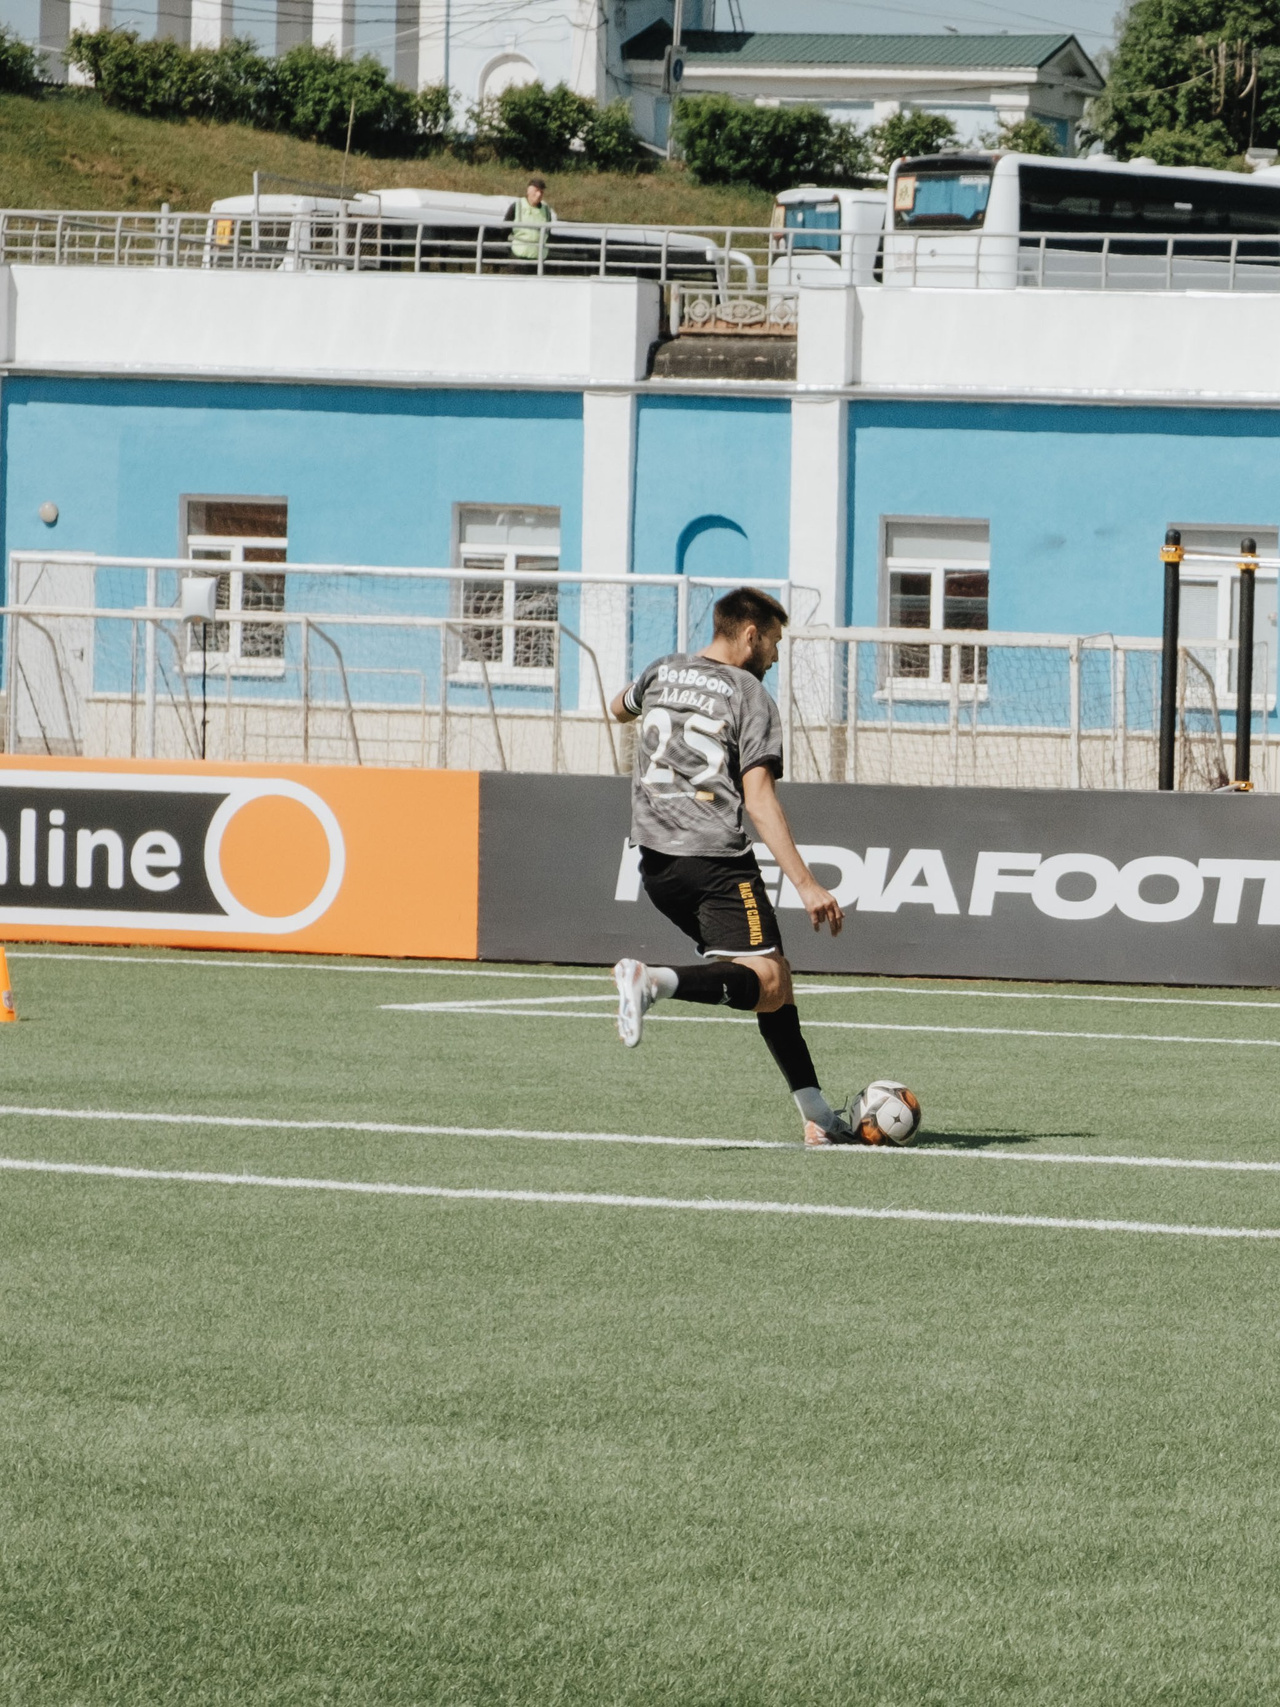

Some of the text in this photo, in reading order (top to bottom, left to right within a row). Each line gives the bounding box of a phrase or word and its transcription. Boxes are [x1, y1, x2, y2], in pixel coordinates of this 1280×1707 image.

[657, 664, 734, 697] BetBoom
[640, 707, 727, 785] 25
[0, 808, 181, 892] line
[738, 882, 763, 946] НАС НЕ СЛОМАТЬ
